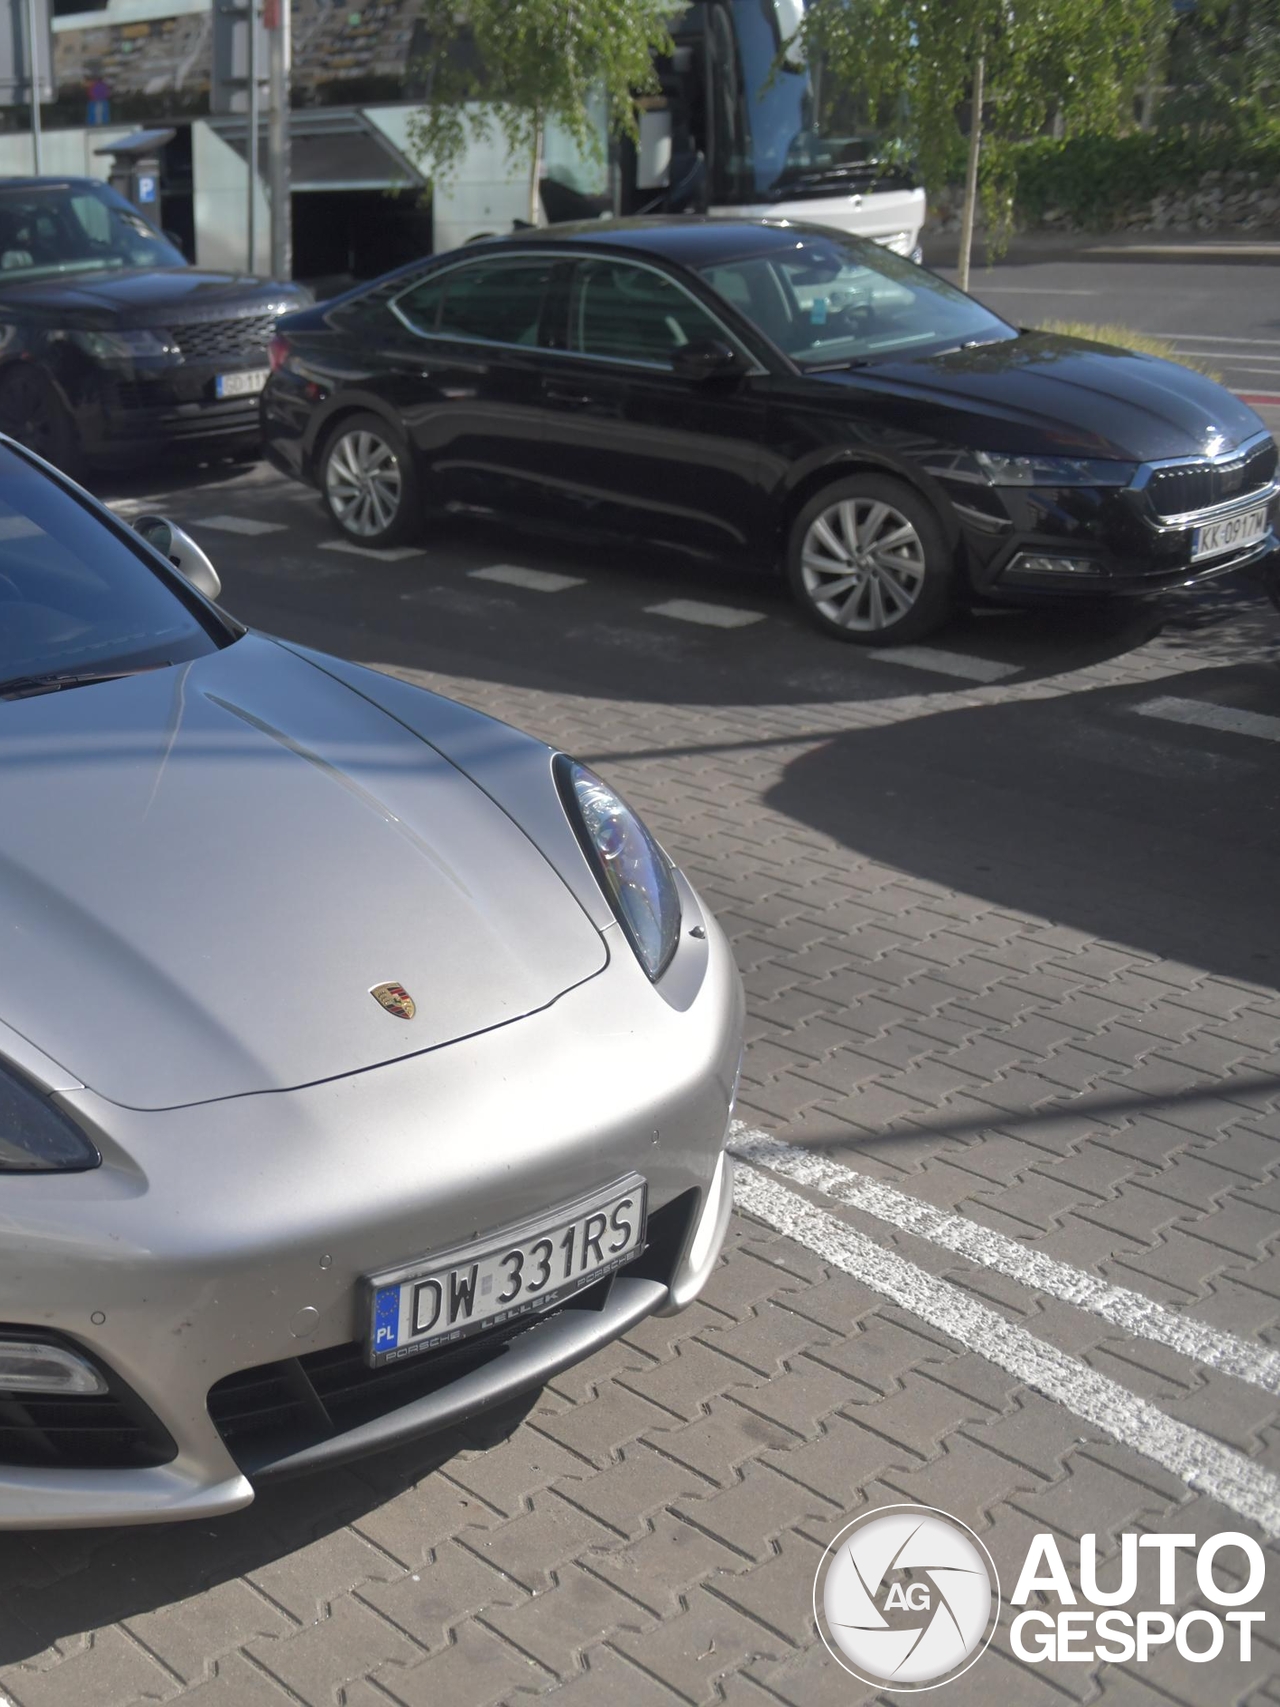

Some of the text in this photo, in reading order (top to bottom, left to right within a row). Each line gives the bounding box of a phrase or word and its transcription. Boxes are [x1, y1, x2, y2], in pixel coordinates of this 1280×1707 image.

[140, 178, 154, 200] P
[1201, 525, 1221, 551] KK
[410, 1197, 634, 1338] DW 331RS
[577, 1251, 635, 1288] PORSCHE
[481, 1291, 559, 1329] LELLEK
[376, 1326, 395, 1344] PL
[385, 1330, 461, 1361] PORSCHE
